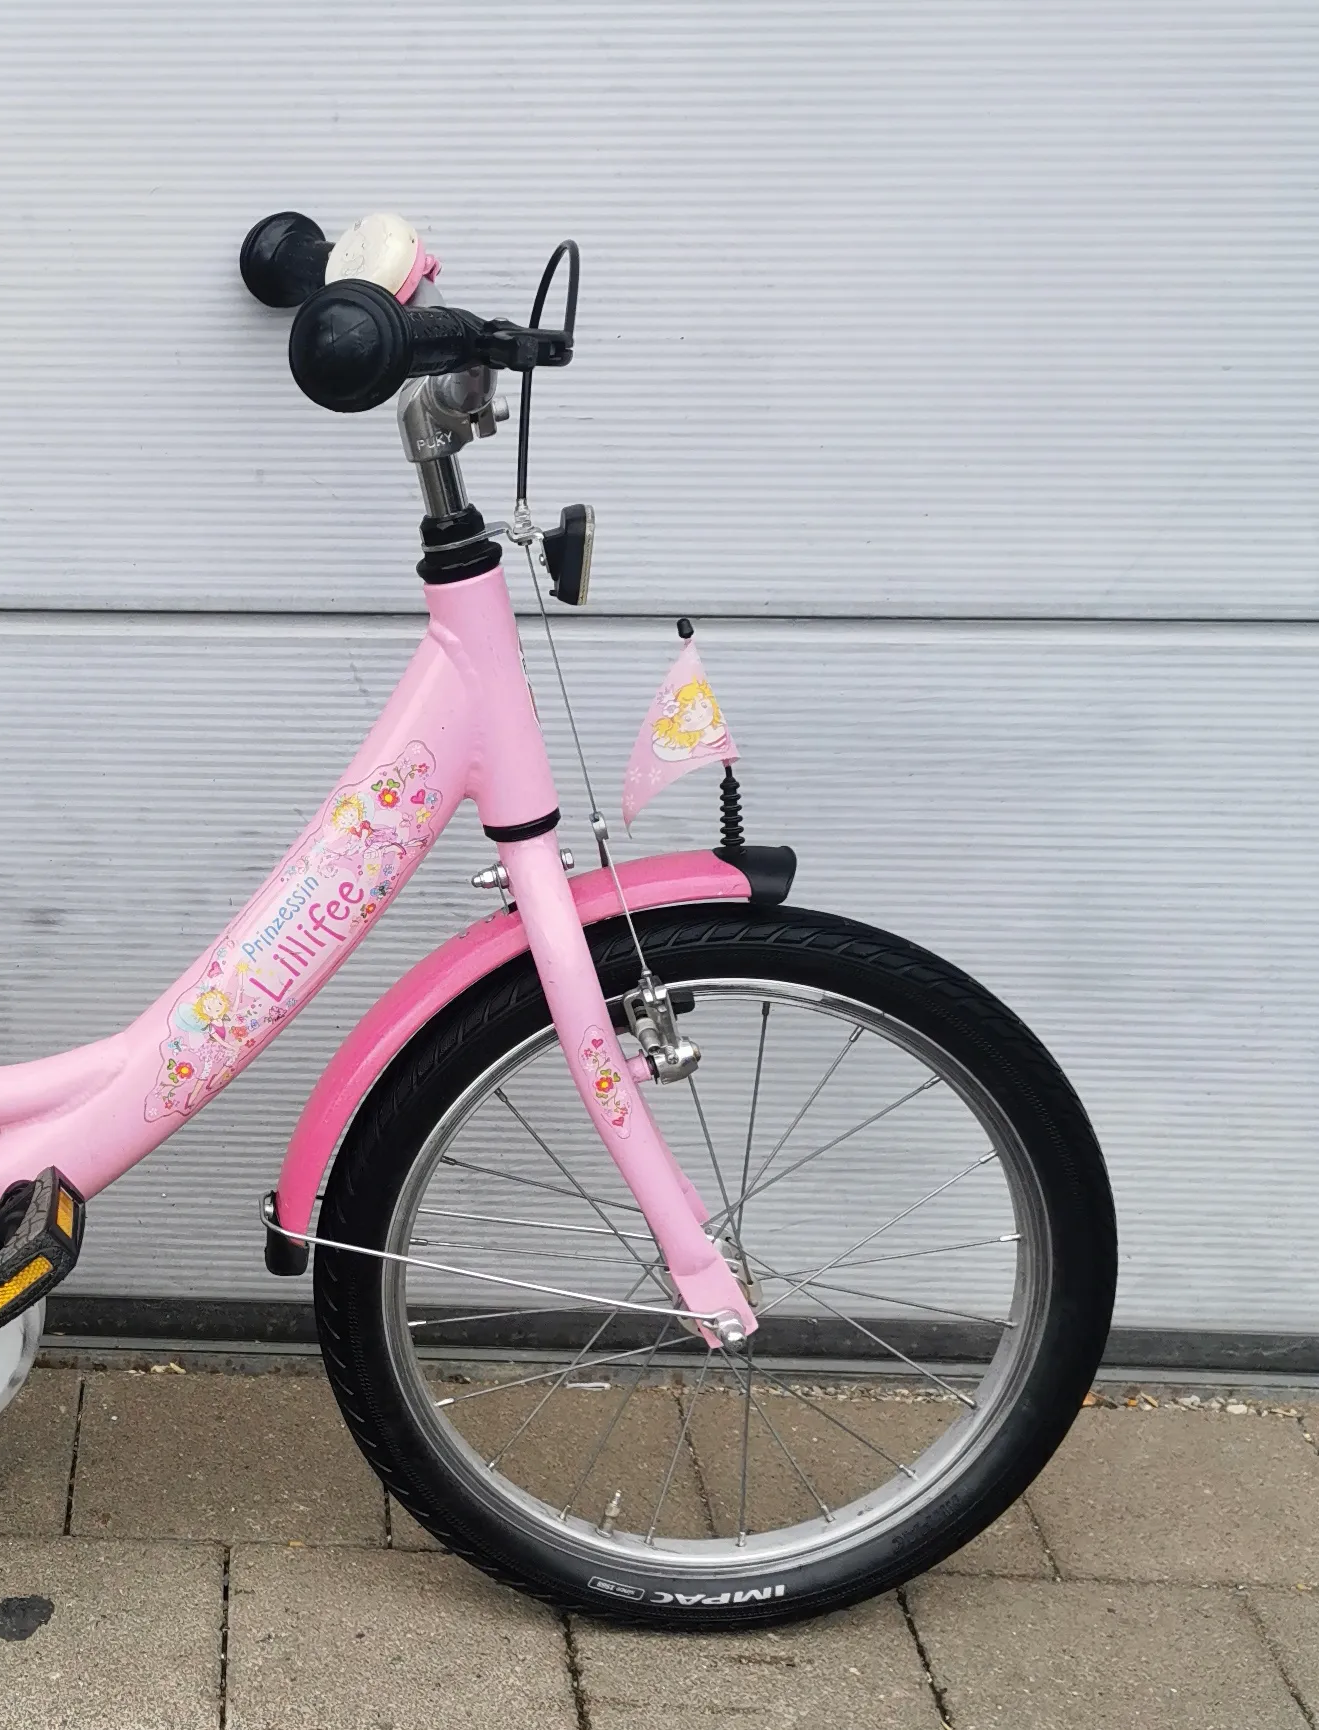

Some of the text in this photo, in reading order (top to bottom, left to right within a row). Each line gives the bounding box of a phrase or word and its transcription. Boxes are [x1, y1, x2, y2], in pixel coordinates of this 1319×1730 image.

[417, 431, 453, 450] PUKY
[241, 876, 319, 963] Prinzessin
[248, 881, 365, 1003] Lillifee
[650, 1584, 785, 1606] IMPAC
